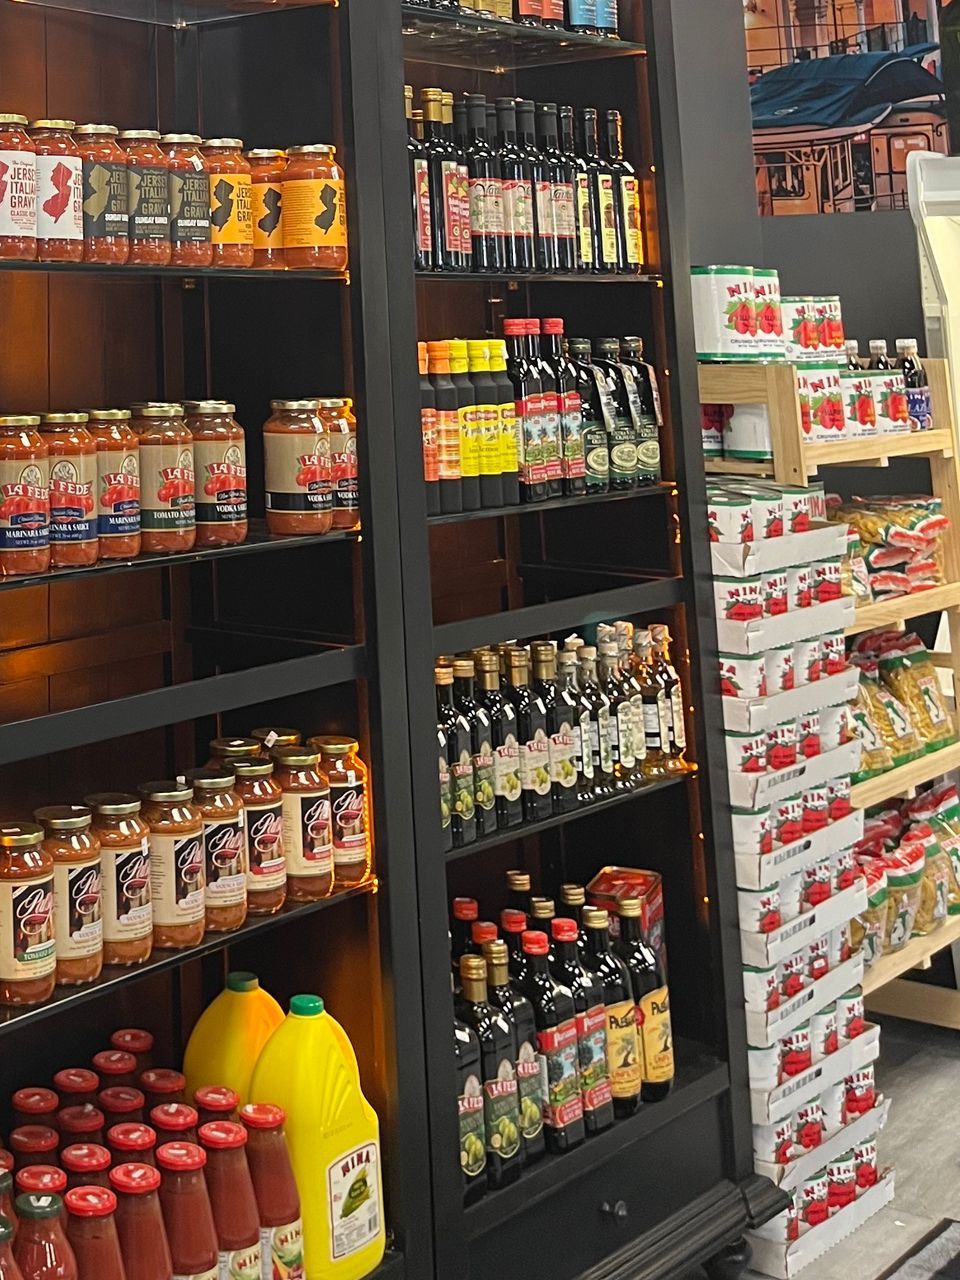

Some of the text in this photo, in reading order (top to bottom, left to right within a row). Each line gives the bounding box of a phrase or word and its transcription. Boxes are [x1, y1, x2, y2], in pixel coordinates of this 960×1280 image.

[10, 195, 36, 210] GRAVY
[141, 202, 168, 216] GRAVY
[304, 455, 319, 466] LA
[334, 452, 349, 463] LA
[167, 468, 182, 479] LA
[213, 463, 228, 474] LA
[110, 474, 125, 484] LA
[7, 486, 25, 496] LA
[59, 480, 90, 496] FEDE
[216, 503, 237, 513] VODKA
[153, 511, 179, 519] TOMATO
[73, 522, 90, 531] SAUCE
[5, 528, 38, 539] MARINARA
[341, 1150, 371, 1178] NINA
